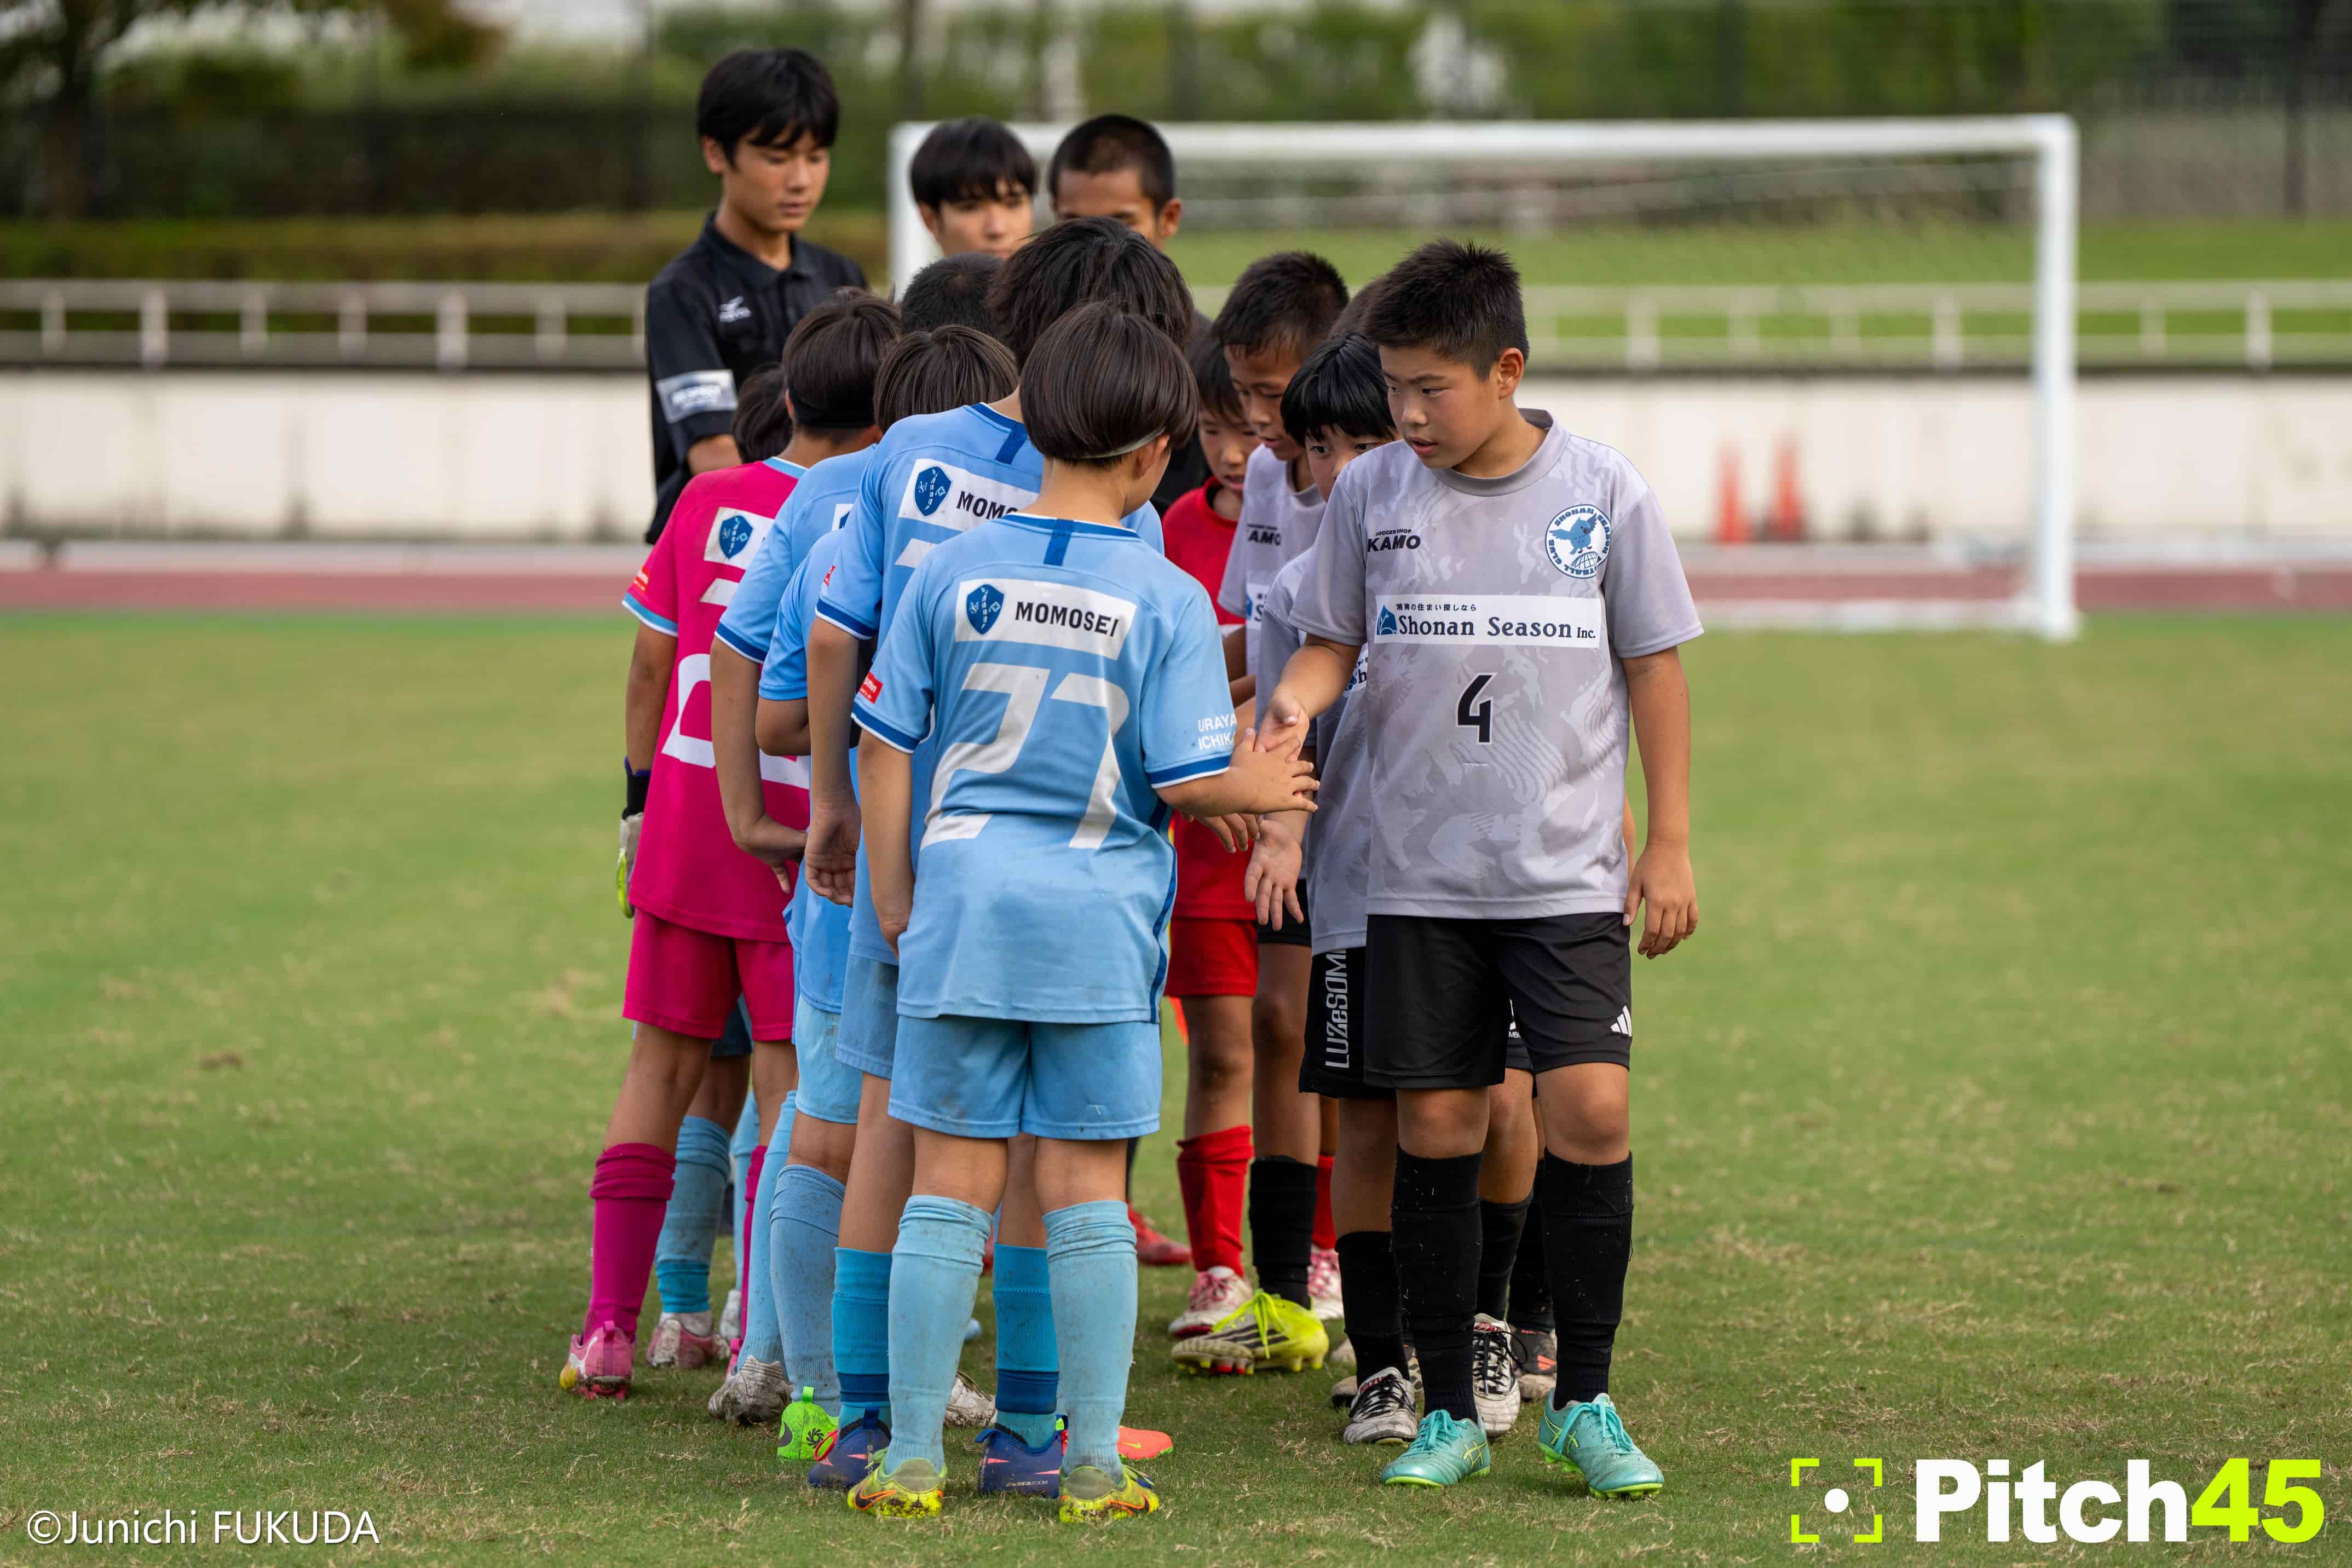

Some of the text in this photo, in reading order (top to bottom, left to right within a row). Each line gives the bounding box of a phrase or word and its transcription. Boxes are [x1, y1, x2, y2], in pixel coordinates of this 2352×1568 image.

[1247, 529, 1281, 546] AMO
[1368, 535, 1421, 552] KAMO
[1015, 601, 1119, 637] MOMOSEI
[1399, 615, 1596, 639] Shonan Season Inc.
[1456, 673, 1496, 745] 4
[1198, 731, 1235, 750] ICHIK
[920, 662, 1129, 850] 27
[1325, 949, 1350, 1069] LUZeSOM
